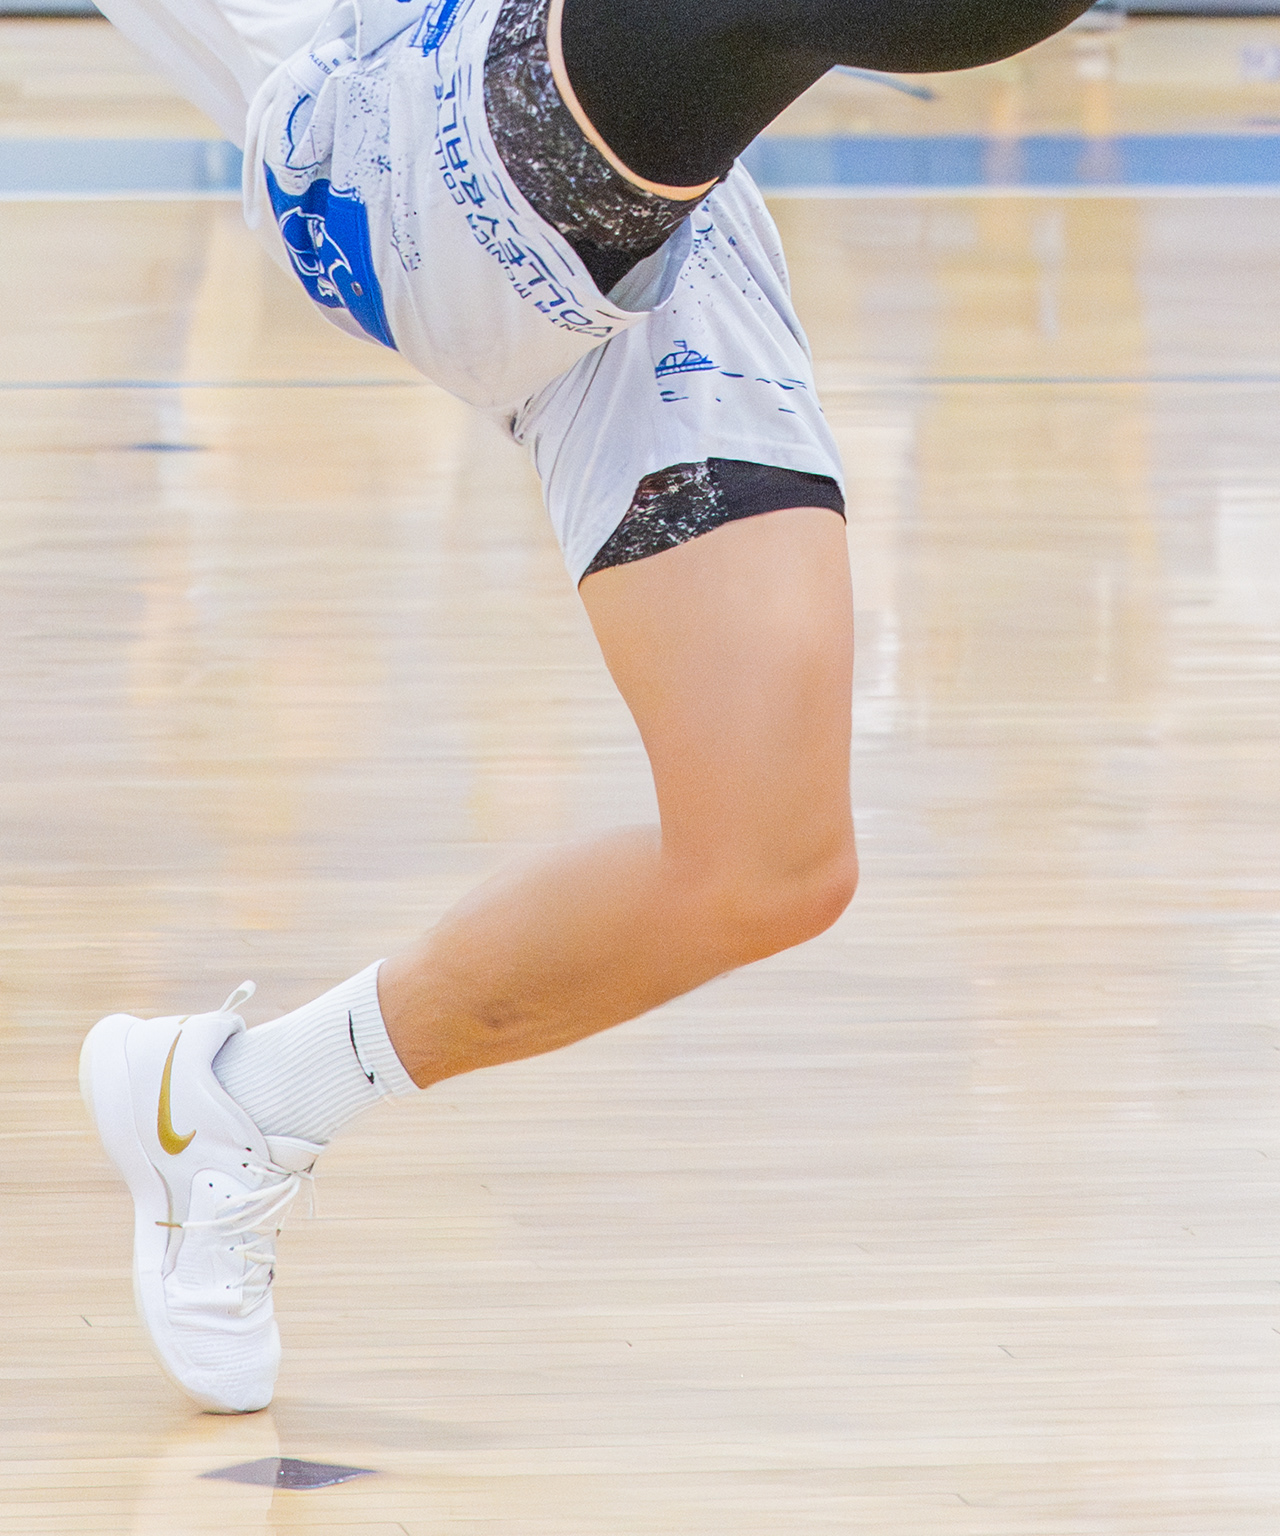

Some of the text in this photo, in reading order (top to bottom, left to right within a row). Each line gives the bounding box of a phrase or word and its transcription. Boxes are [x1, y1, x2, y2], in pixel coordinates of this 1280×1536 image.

[433, 83, 466, 206] COLLE
[441, 70, 614, 334] VOLLEYBALL
[465, 212, 533, 300] MONICA
